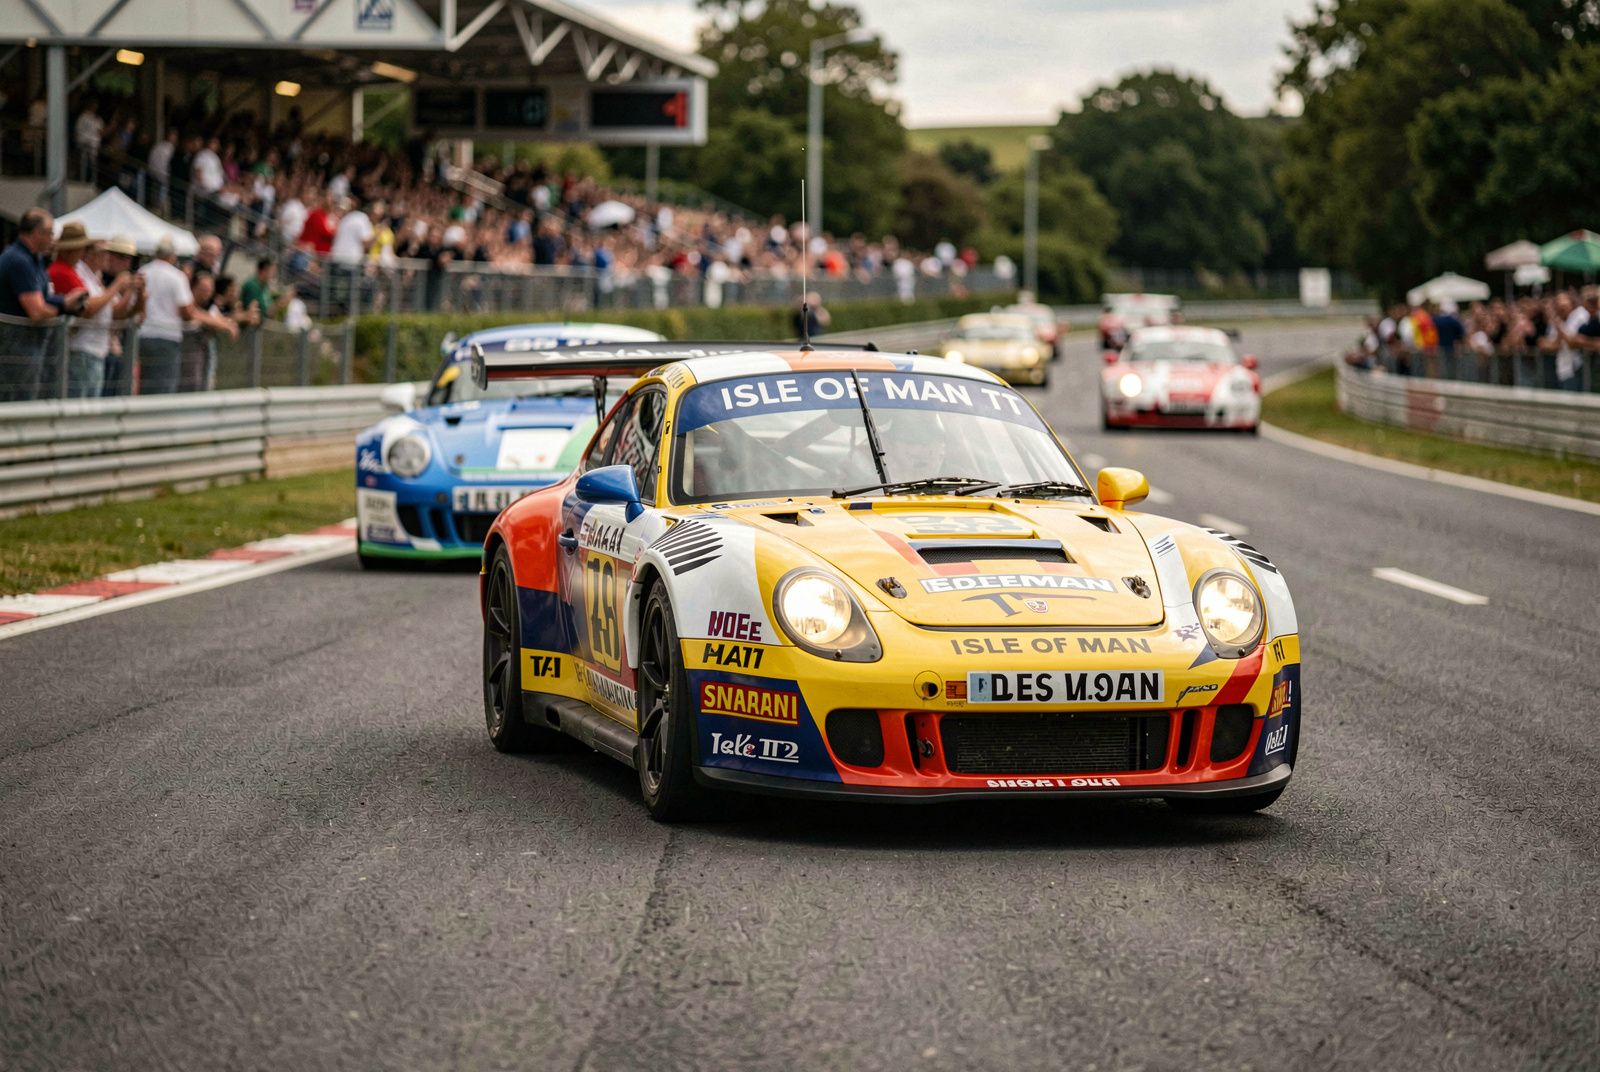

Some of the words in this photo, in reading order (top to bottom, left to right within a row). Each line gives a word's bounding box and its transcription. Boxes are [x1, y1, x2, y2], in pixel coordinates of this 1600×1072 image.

[721, 379, 802, 410] ISLE
[814, 377, 869, 400] OF
[883, 377, 972, 407] MAN
[981, 388, 1023, 416] TT
[950, 638, 1023, 655] ISLE
[1031, 637, 1067, 654] OF
[1077, 637, 1152, 654] MAN
[703, 685, 797, 719] SNARANI
